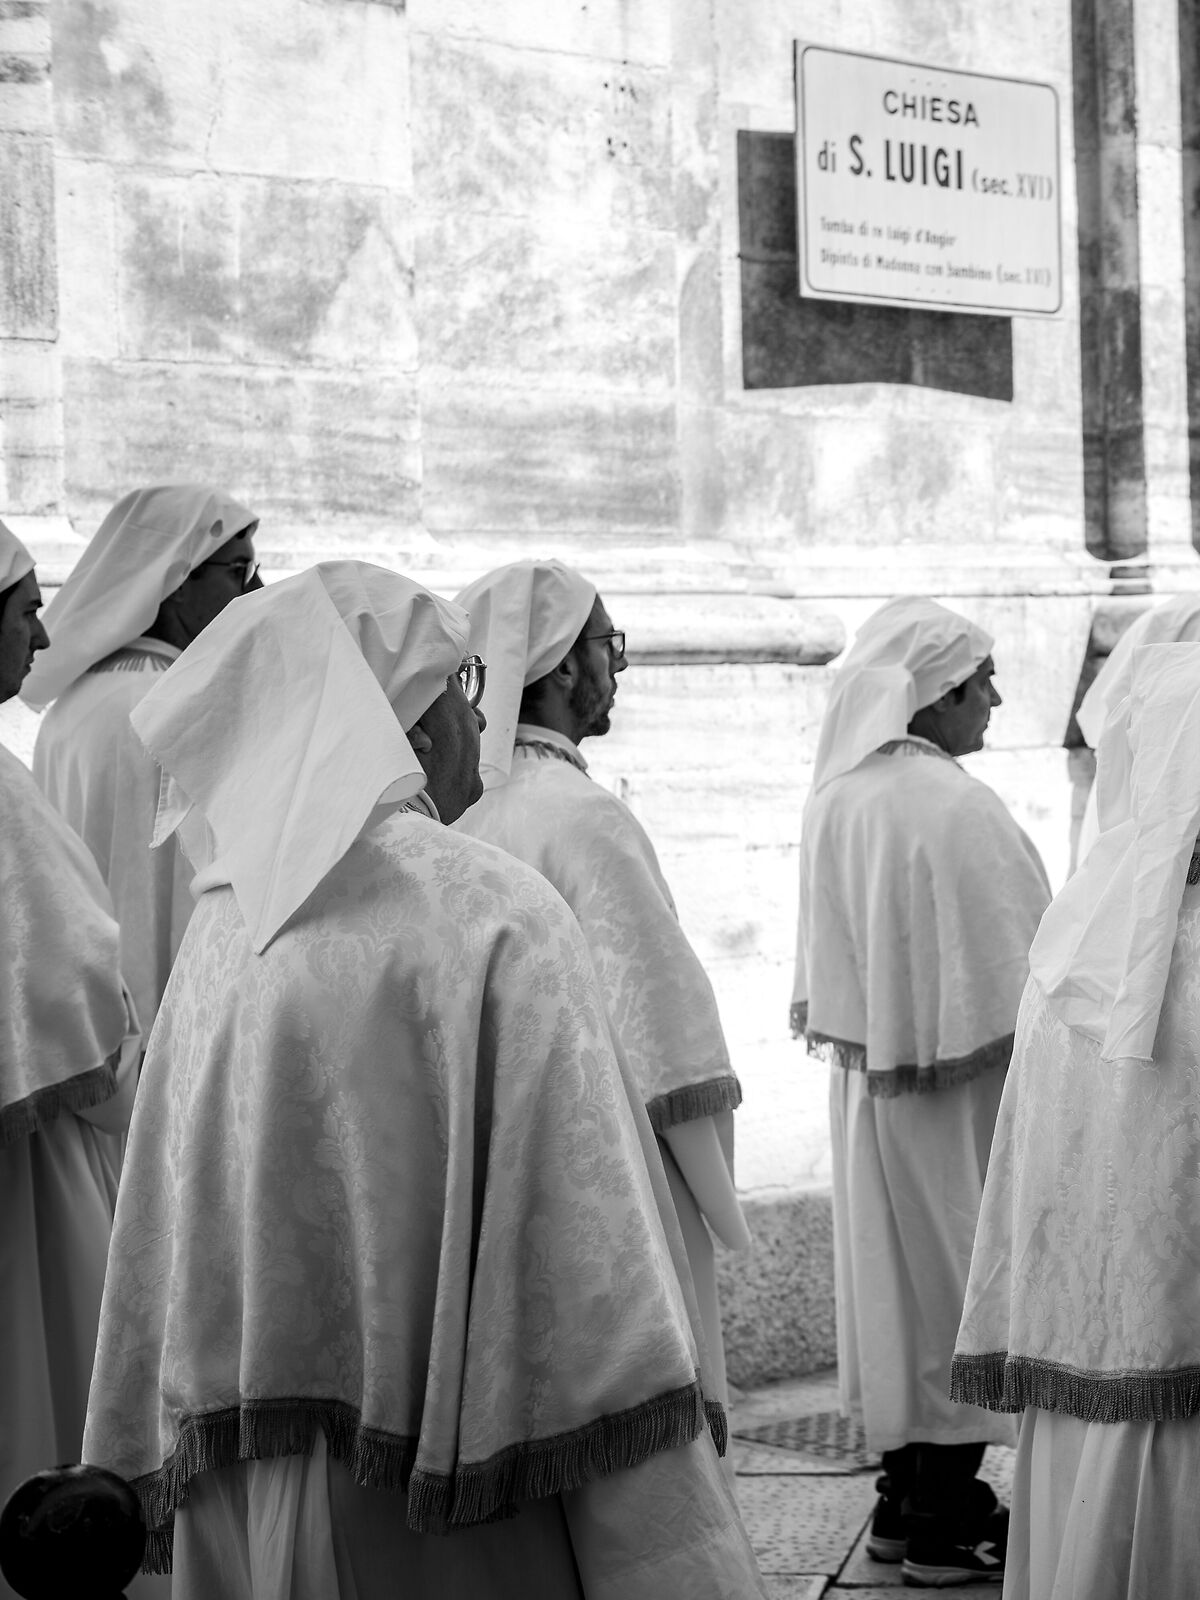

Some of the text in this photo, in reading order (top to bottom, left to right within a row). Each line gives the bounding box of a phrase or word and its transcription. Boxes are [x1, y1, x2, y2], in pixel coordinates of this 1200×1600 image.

[883, 90, 980, 128] CHIESA
[817, 140, 837, 173] di
[849, 134, 872, 177] S.
[885, 139, 963, 190] LUIGI
